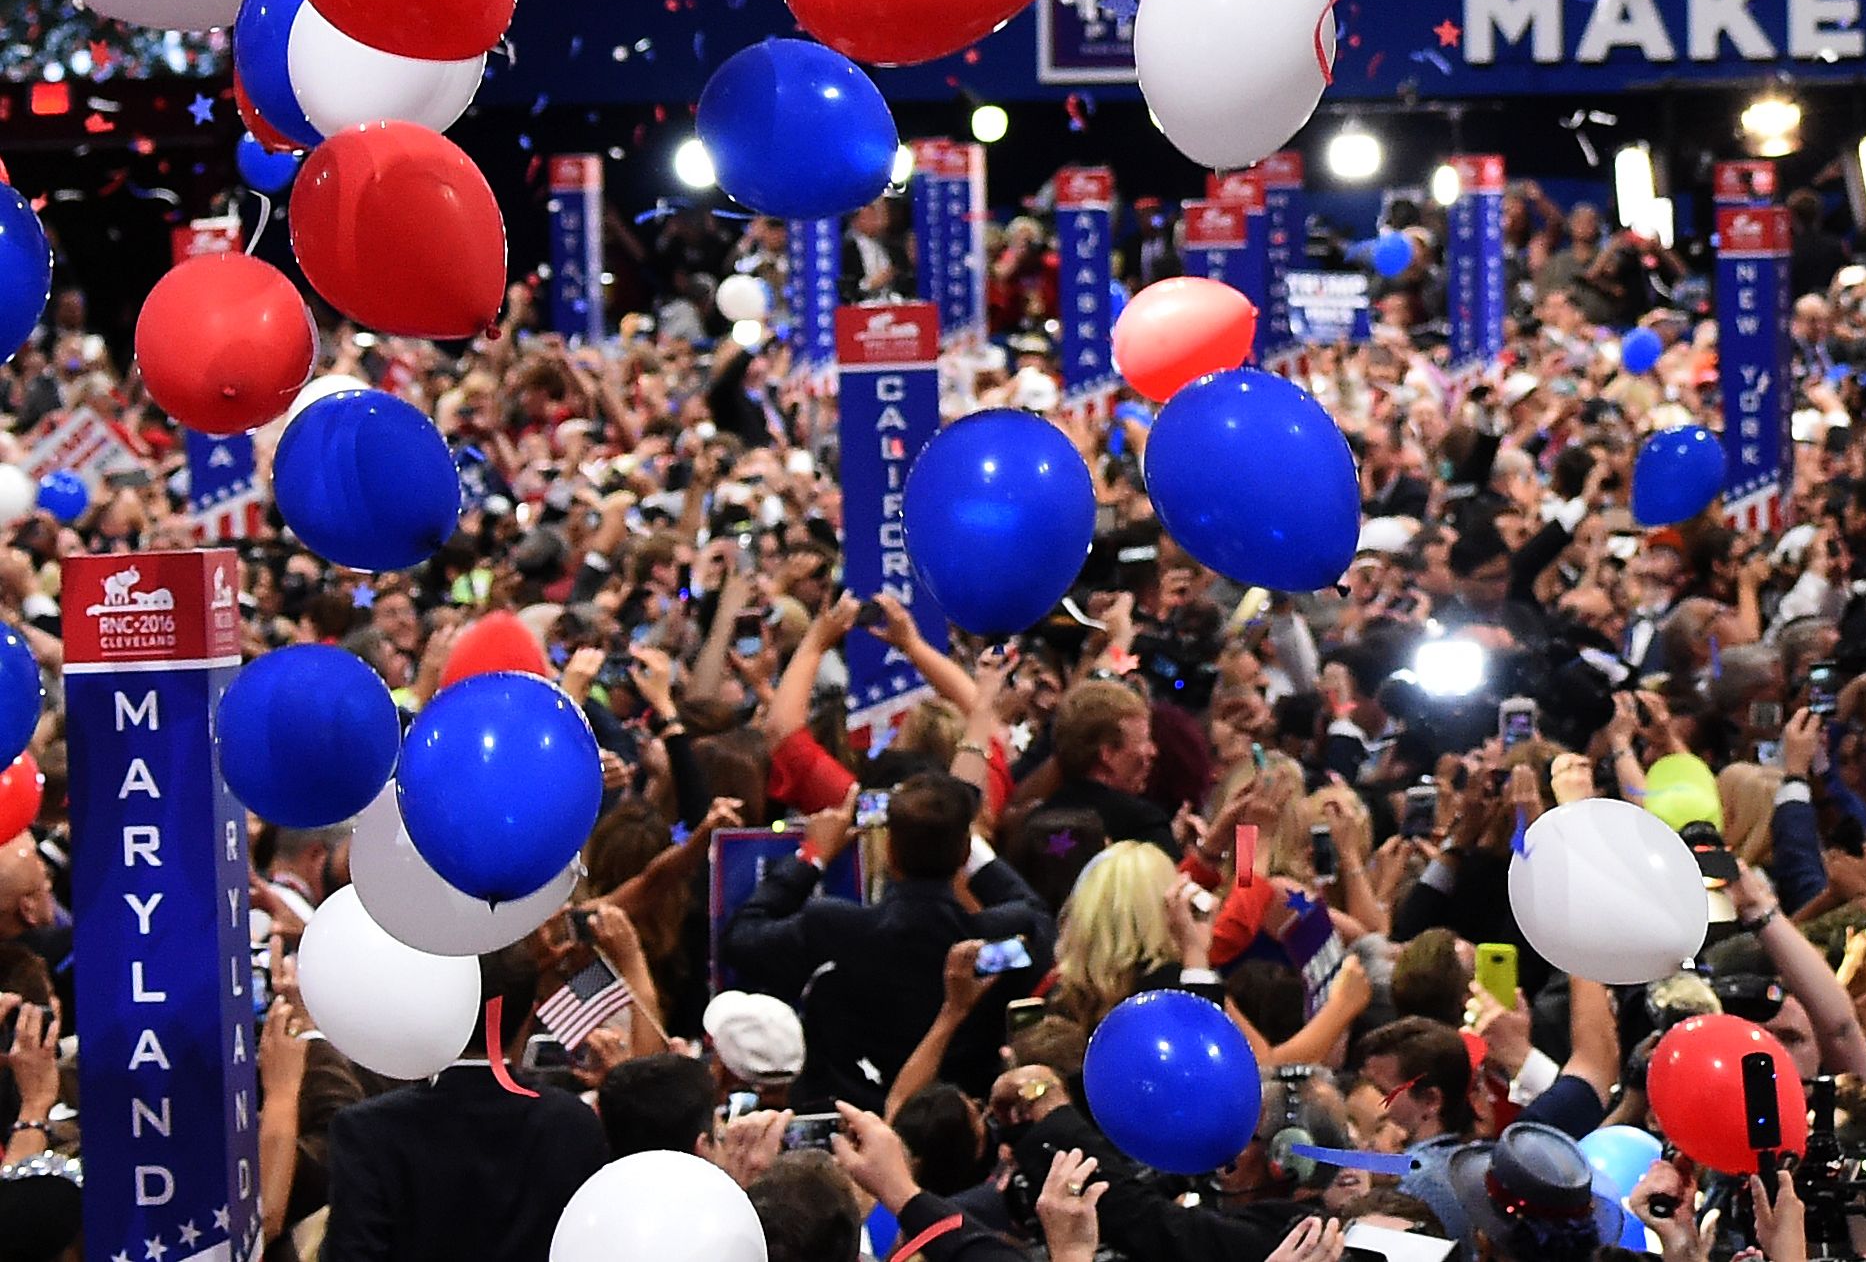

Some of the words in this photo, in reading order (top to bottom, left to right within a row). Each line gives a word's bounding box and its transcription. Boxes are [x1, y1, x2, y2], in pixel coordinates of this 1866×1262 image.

[1735, 263, 1761, 336] NEW
[1738, 365, 1762, 465] YORK
[875, 374, 914, 666] CALIFORNA
[100, 634, 176, 649] CLEVELAND
[115, 689, 175, 1206] MARYLAND
[224, 819, 252, 1201] RYLAND
